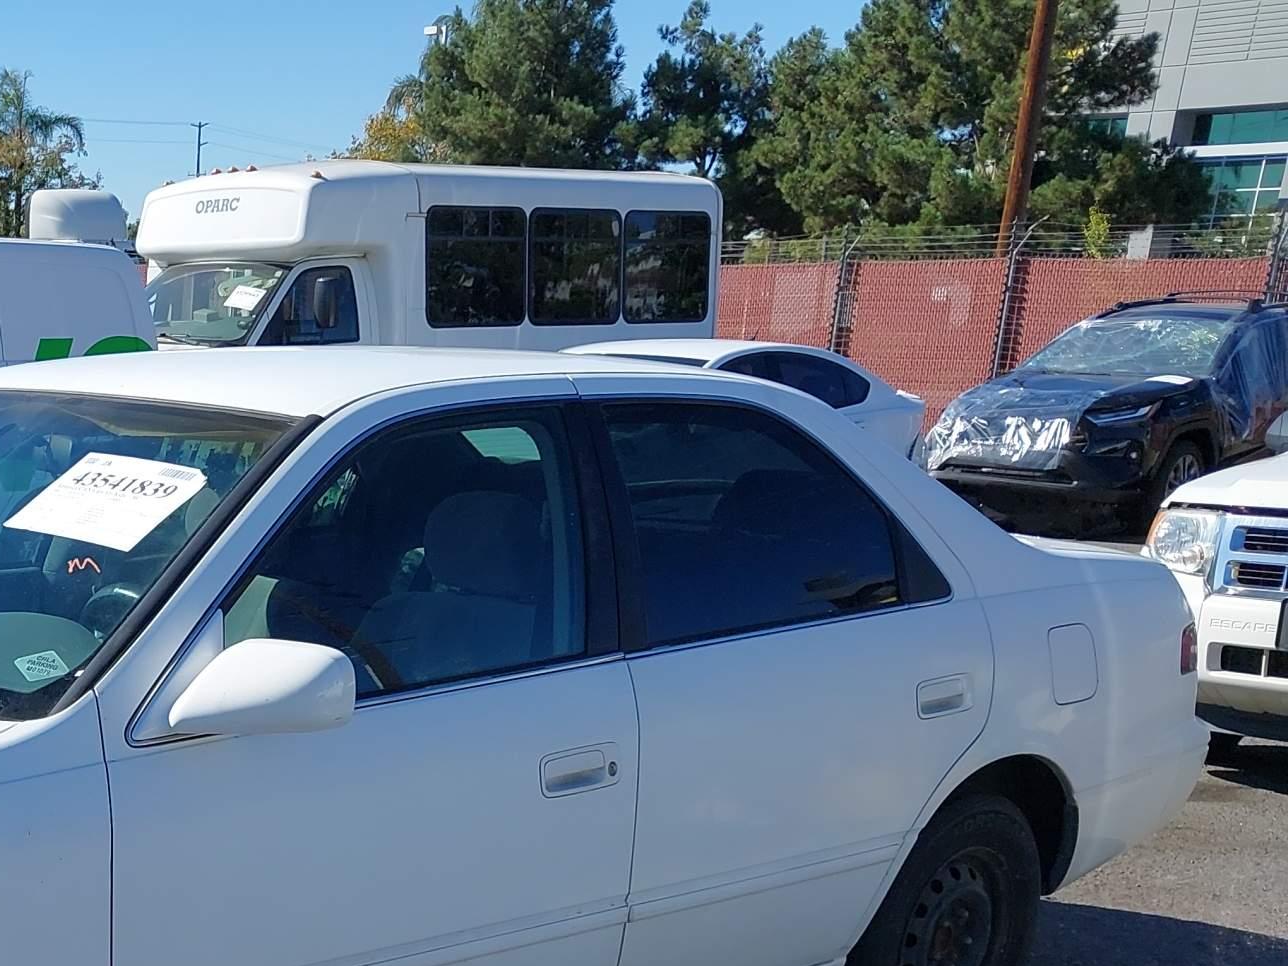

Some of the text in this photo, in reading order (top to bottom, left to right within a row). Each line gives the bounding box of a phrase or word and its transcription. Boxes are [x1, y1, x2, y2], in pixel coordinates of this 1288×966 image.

[195, 196, 241, 214] OPARC
[73, 471, 178, 499] 43541839
[1210, 618, 1277, 633] ESCAPE
